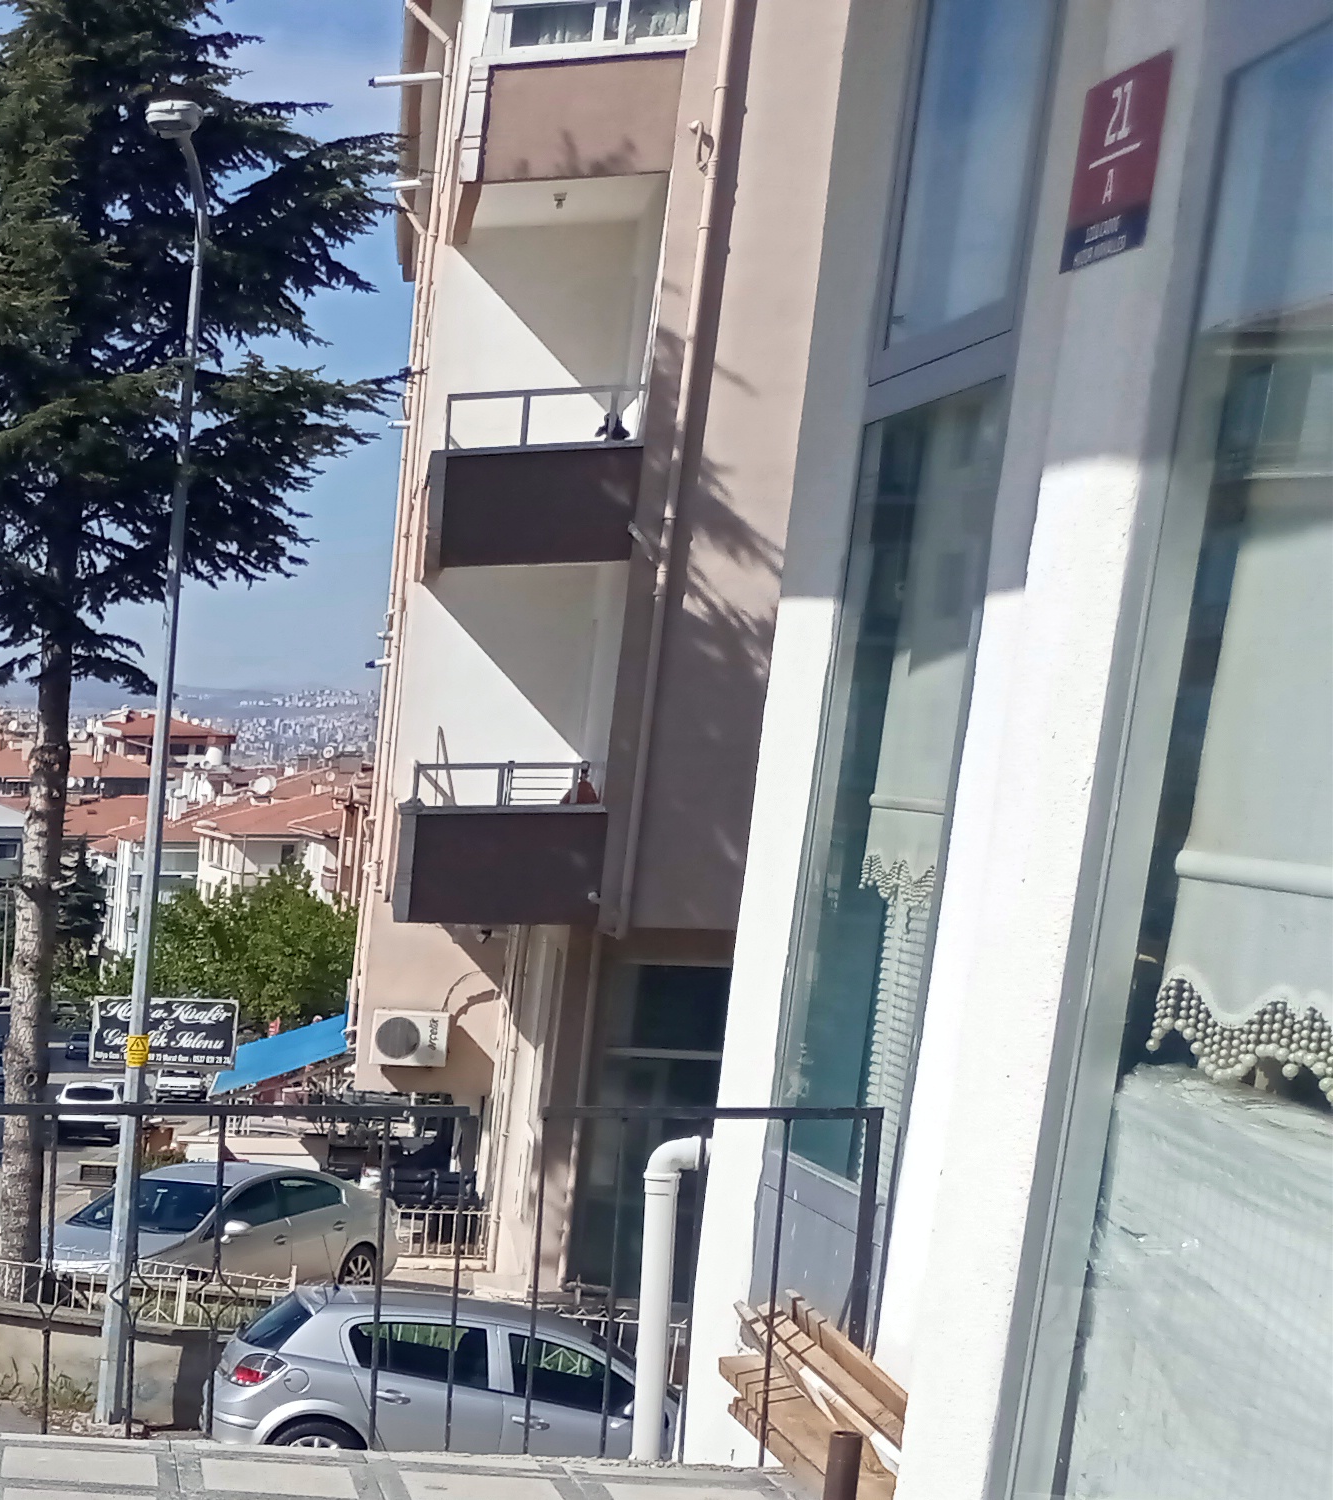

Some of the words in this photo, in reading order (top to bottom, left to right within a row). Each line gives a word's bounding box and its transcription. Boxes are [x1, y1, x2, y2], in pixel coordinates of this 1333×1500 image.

[1103, 80, 1133, 148] 21
[1101, 168, 1114, 205] A
[159, 1020, 175, 1031] &
[171, 1031, 225, 1049] Salonu
[428, 1018, 440, 1051] arçelik
